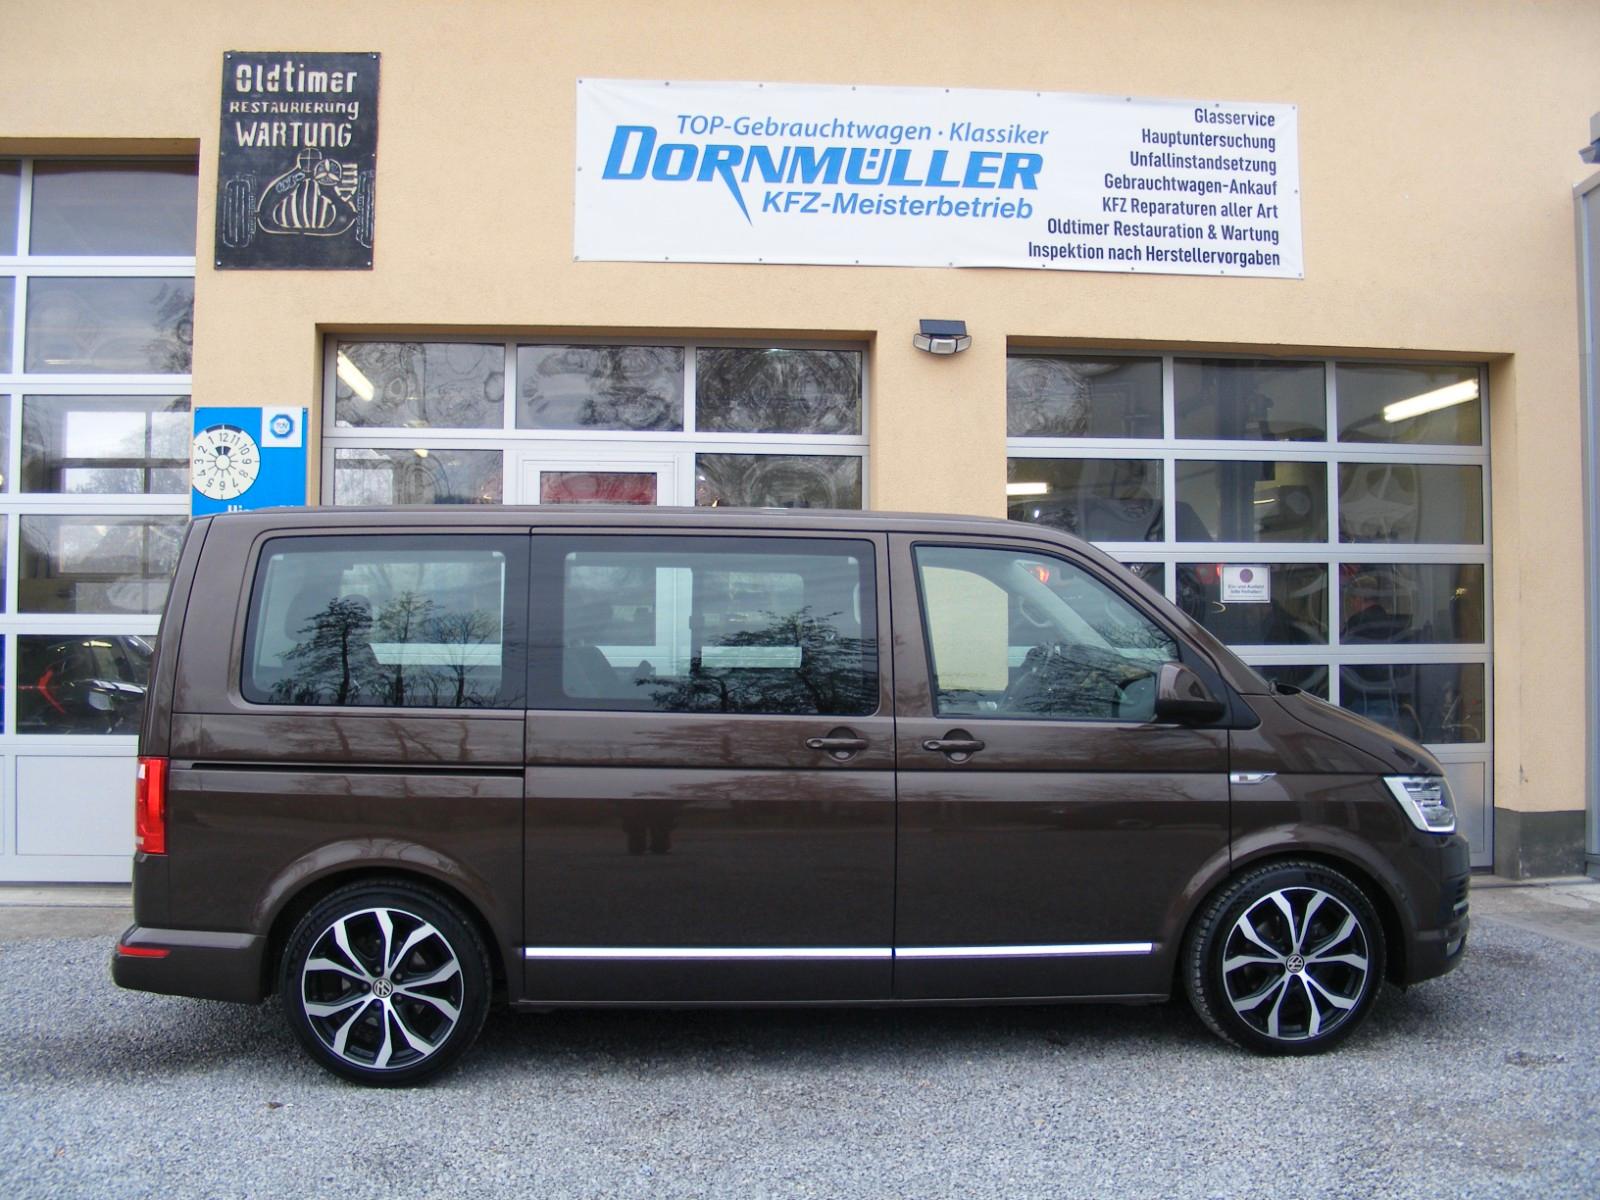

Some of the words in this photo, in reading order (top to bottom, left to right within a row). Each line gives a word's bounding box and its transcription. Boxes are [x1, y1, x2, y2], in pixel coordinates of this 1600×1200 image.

[236, 60, 358, 93] Oldtimer
[677, 114, 932, 145] TOP-Gebrauchtwagen
[949, 122, 1049, 145] Klassiker
[1194, 107, 1276, 127] Glasservice
[1141, 127, 1276, 153] Hauptuntersuchung
[1130, 150, 1277, 176] Unfallinstandsetzung
[1104, 172, 1277, 197] Gebrauchtwagen-Ankauf
[762, 190, 1033, 220] KFZ-Meisterbetrieb
[1102, 196, 1128, 213] KFZ
[1130, 197, 1217, 218] Reparaturen
[1220, 201, 1253, 218] aller
[1256, 202, 1279, 219] Art
[1047, 217, 1110, 236] Oldtimer
[1113, 220, 1204, 240] Restauration
[1207, 223, 1218, 240] &
[1220, 224, 1280, 246] Wartung
[1028, 241, 1104, 262] Inspektion
[1108, 244, 1142, 261] nach
[1145, 245, 1281, 269] Herstellervorgaben
[219, 432, 229, 443] 12
